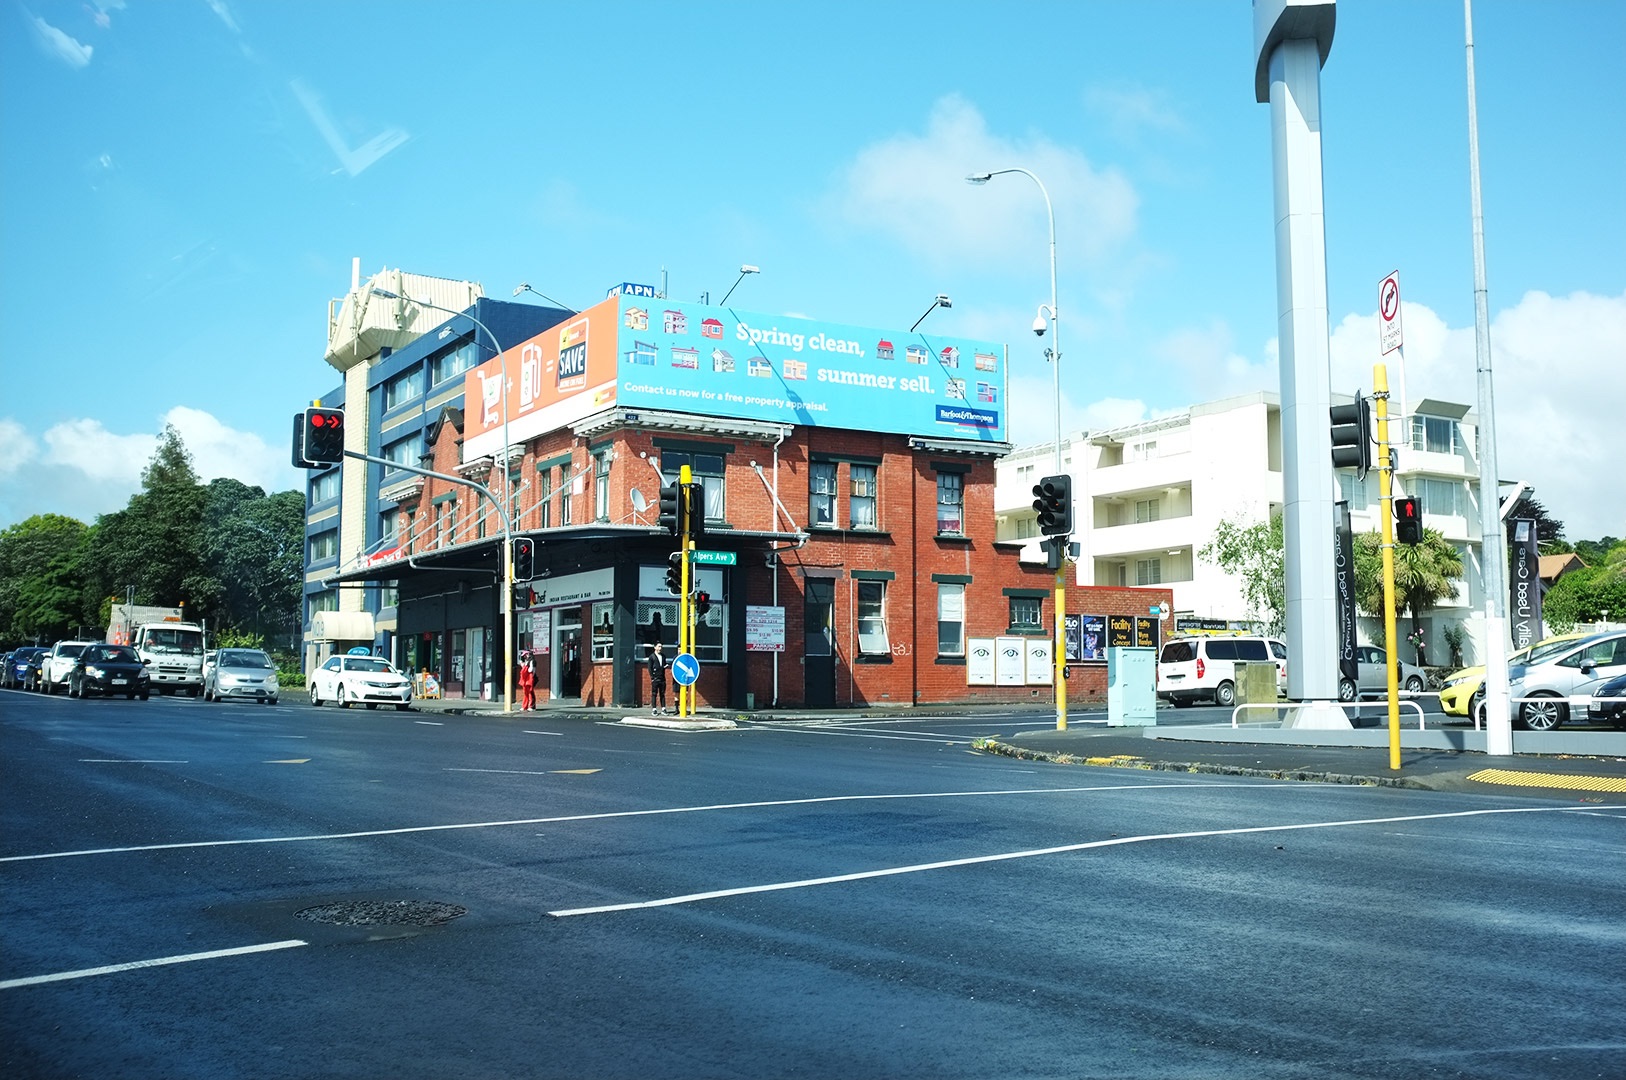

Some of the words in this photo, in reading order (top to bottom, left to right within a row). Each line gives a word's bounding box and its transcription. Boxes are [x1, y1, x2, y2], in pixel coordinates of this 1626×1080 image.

[625, 284, 653, 298] APN
[736, 322, 805, 352] Spring
[808, 333, 865, 358] clean,
[560, 345, 585, 375] SAVE
[817, 368, 896, 389] summer
[900, 375, 935, 394] sell.
[624, 382, 664, 395] Contact
[665, 388, 677, 396] us
[679, 389, 699, 398] now
[701, 390, 716, 400] for
[725, 392, 743, 402] free
[745, 396, 784, 409] property
[786, 399, 828, 411] appraisal.
[693, 552, 713, 561] Alpers
[715, 553, 727, 561] Ave
[1112, 639, 1131, 647] Concept
